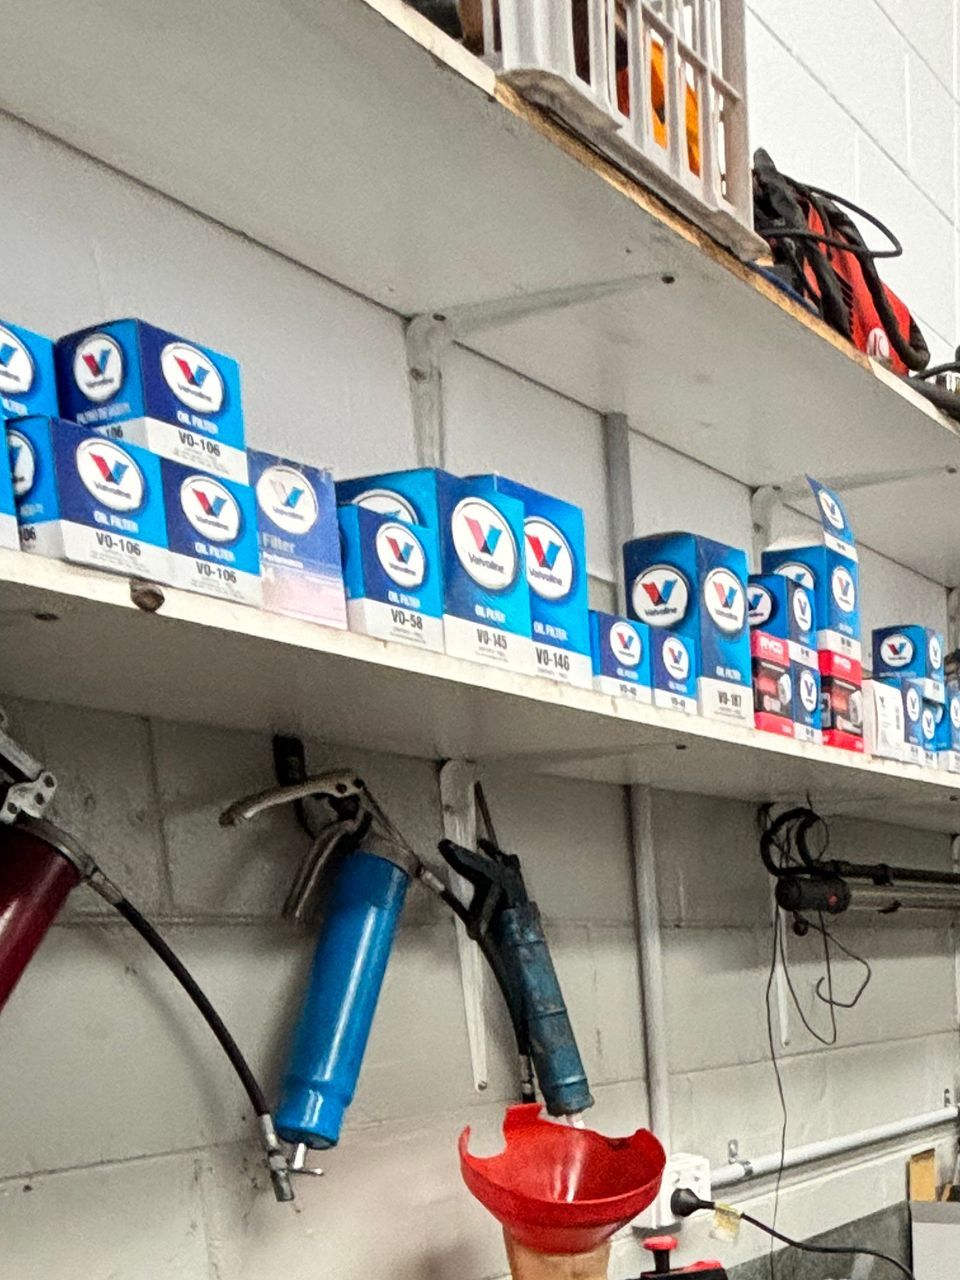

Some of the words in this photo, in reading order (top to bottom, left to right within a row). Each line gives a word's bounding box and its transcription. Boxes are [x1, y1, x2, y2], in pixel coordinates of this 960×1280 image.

[178, 430, 221, 457] VO-106
[95, 531, 141, 557] VO-106
[196, 560, 238, 584] VO-106
[391, 608, 423, 631] VO-58
